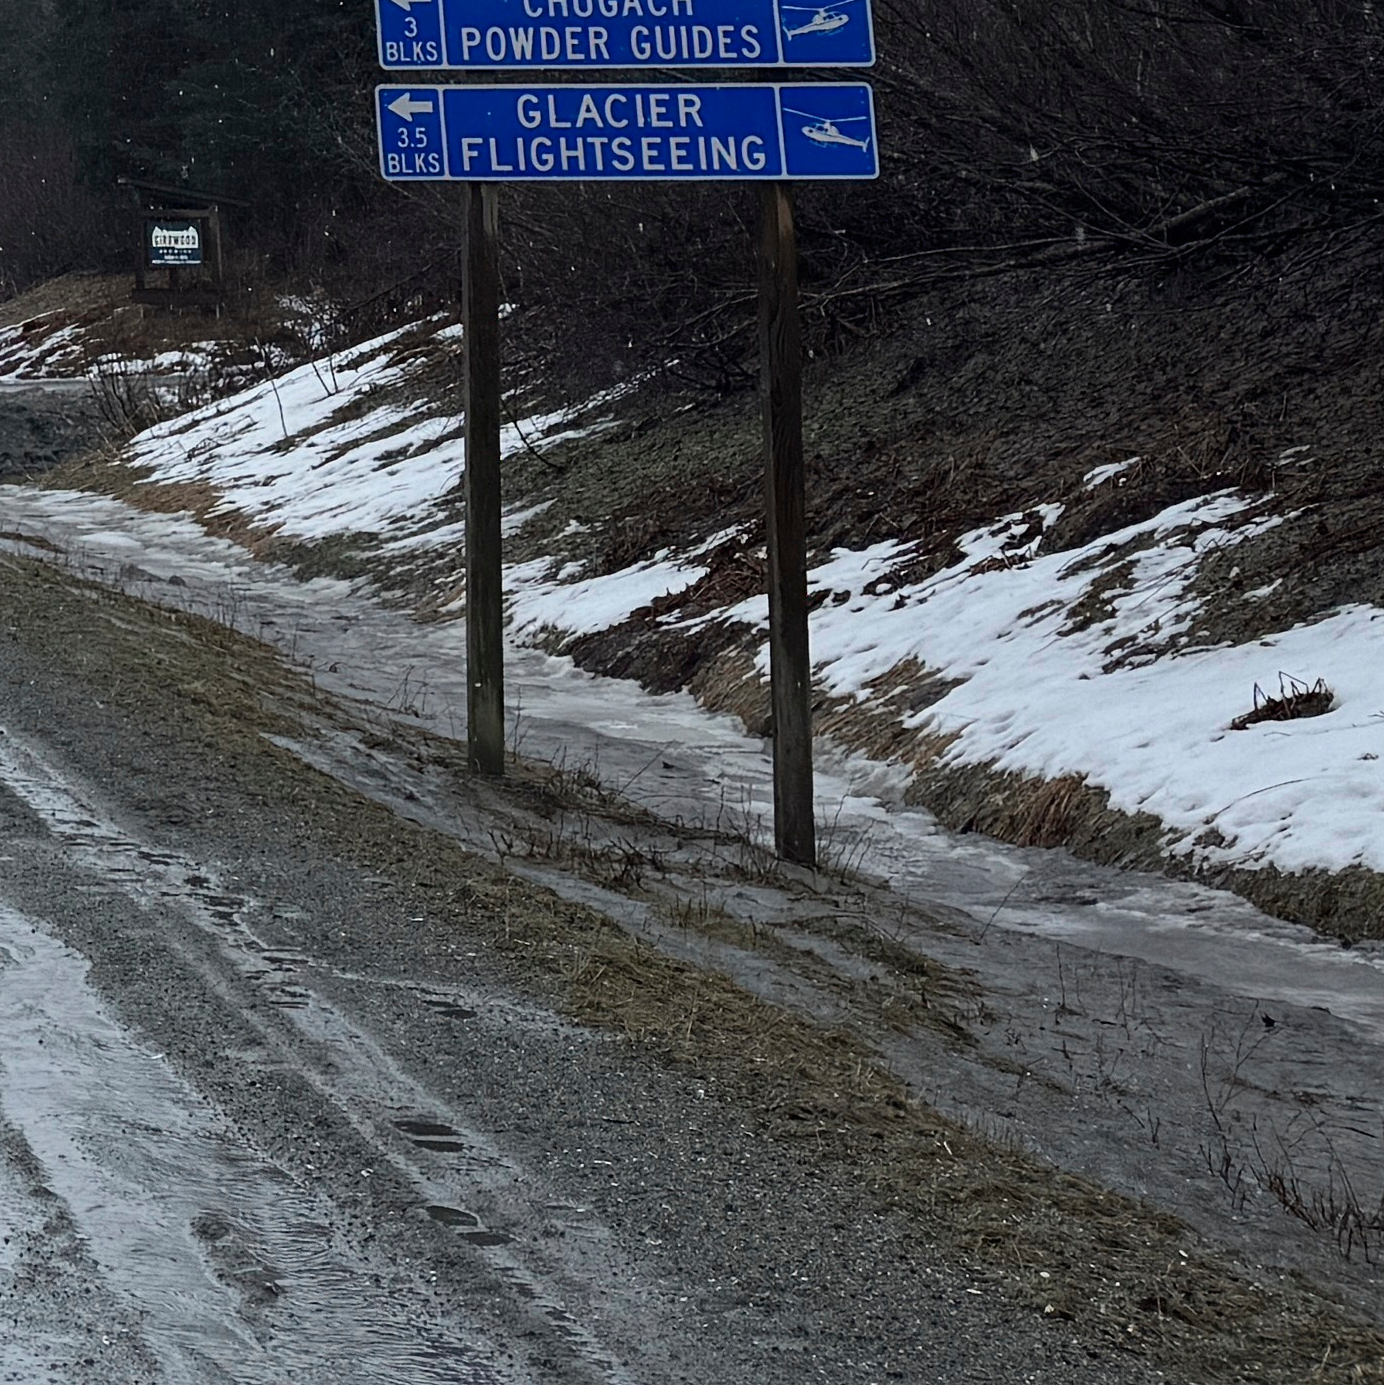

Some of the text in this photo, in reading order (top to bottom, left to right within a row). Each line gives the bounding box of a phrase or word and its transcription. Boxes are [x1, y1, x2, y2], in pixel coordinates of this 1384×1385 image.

[404, 17, 418, 37] 3
[386, 41, 438, 61] BLKS
[461, 25, 761, 61] POWDER GUIDES
[517, 93, 703, 128] GLACIER
[397, 127, 427, 147] 3.5
[387, 153, 440, 173] BLKS
[461, 135, 766, 172] FLIGHTSEEING
